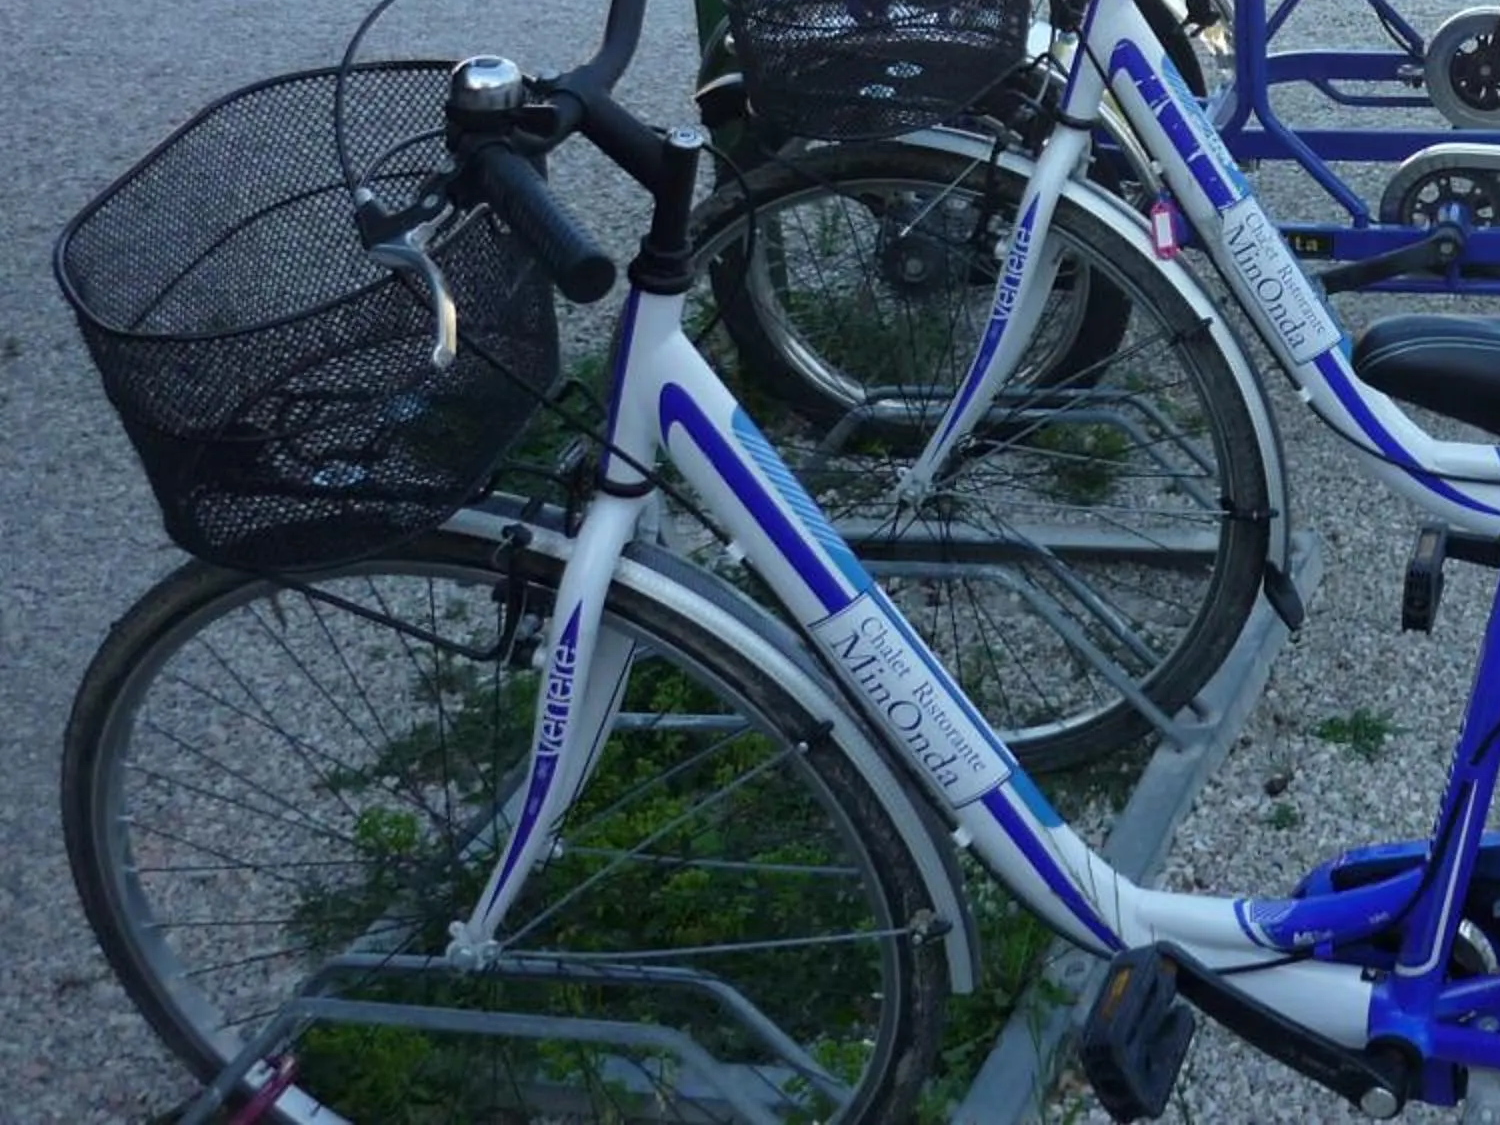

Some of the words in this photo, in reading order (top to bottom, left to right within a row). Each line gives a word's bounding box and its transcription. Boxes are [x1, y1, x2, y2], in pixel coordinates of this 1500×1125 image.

[1222, 225, 1306, 350] MinOnda
[831, 629, 960, 788] MinOnda
[861, 616, 911, 679] Chalet
[912, 680, 987, 773] Ristorante
